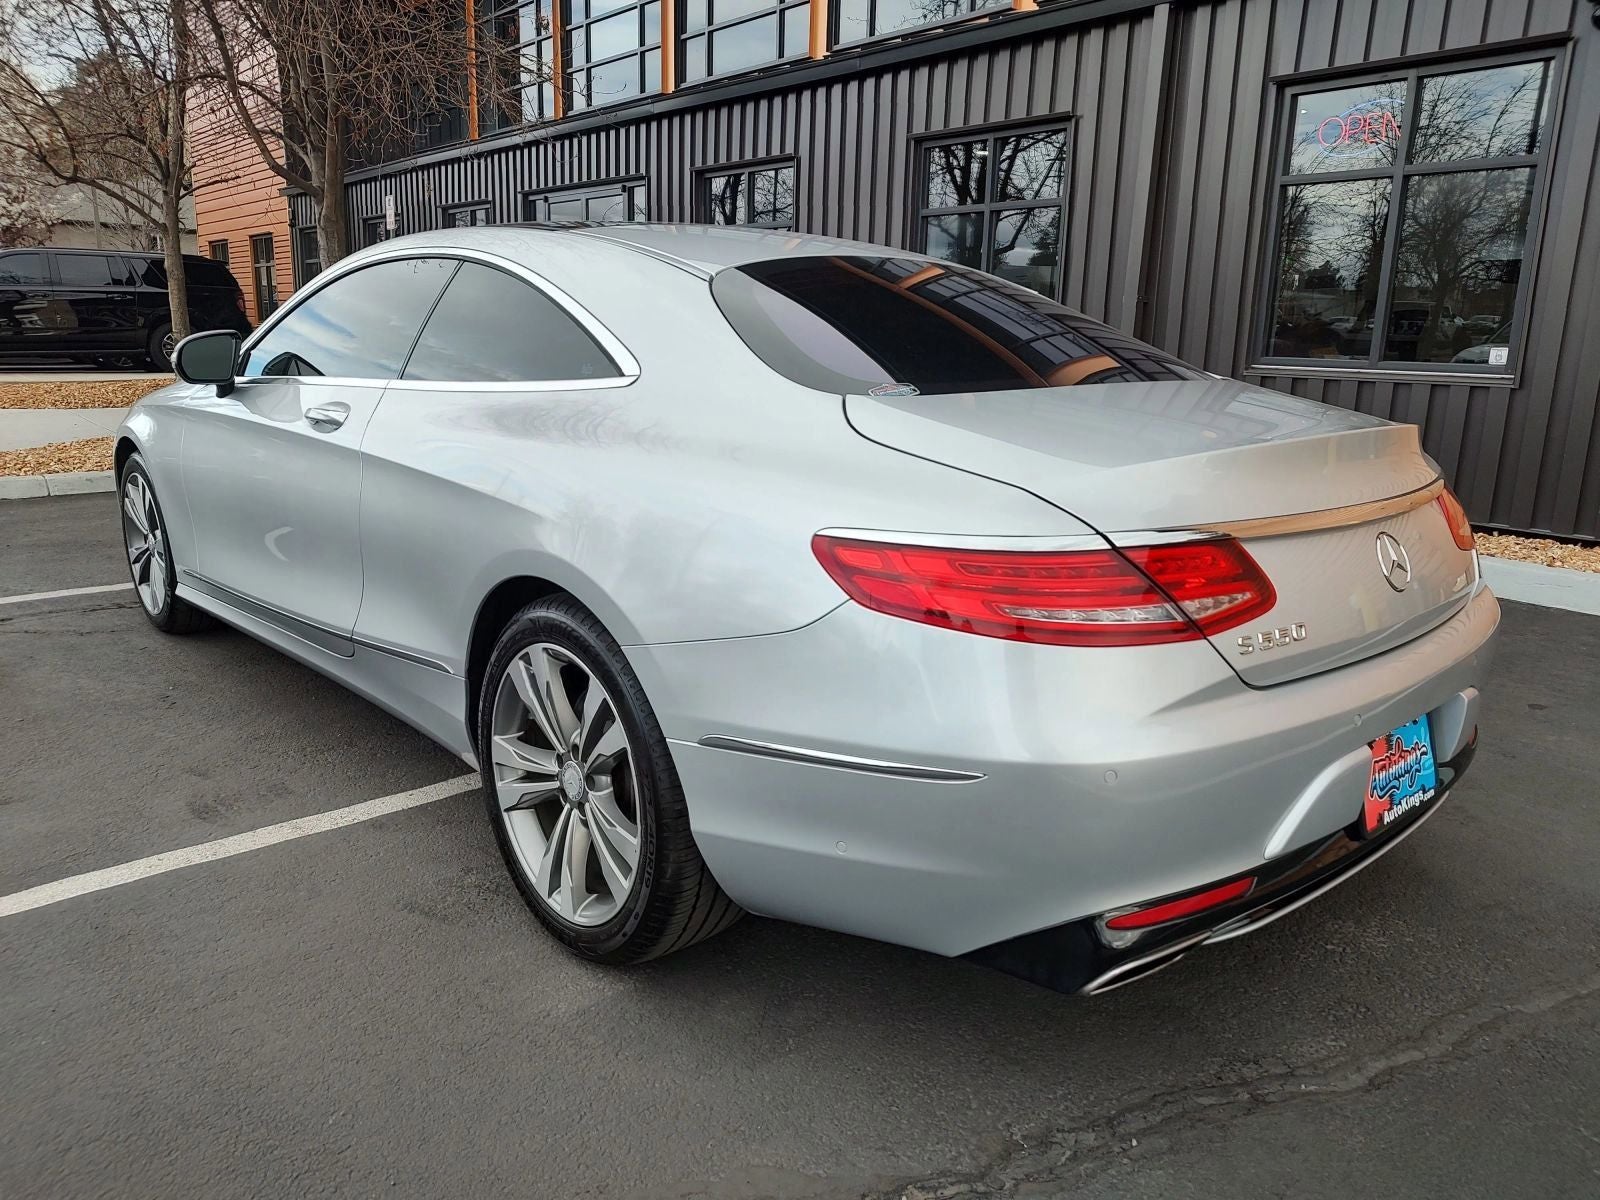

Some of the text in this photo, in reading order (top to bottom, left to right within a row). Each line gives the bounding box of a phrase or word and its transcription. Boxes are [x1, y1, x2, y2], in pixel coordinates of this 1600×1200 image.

[1318, 112, 1401, 147] OPEN
[1237, 622, 1307, 655] S 550
